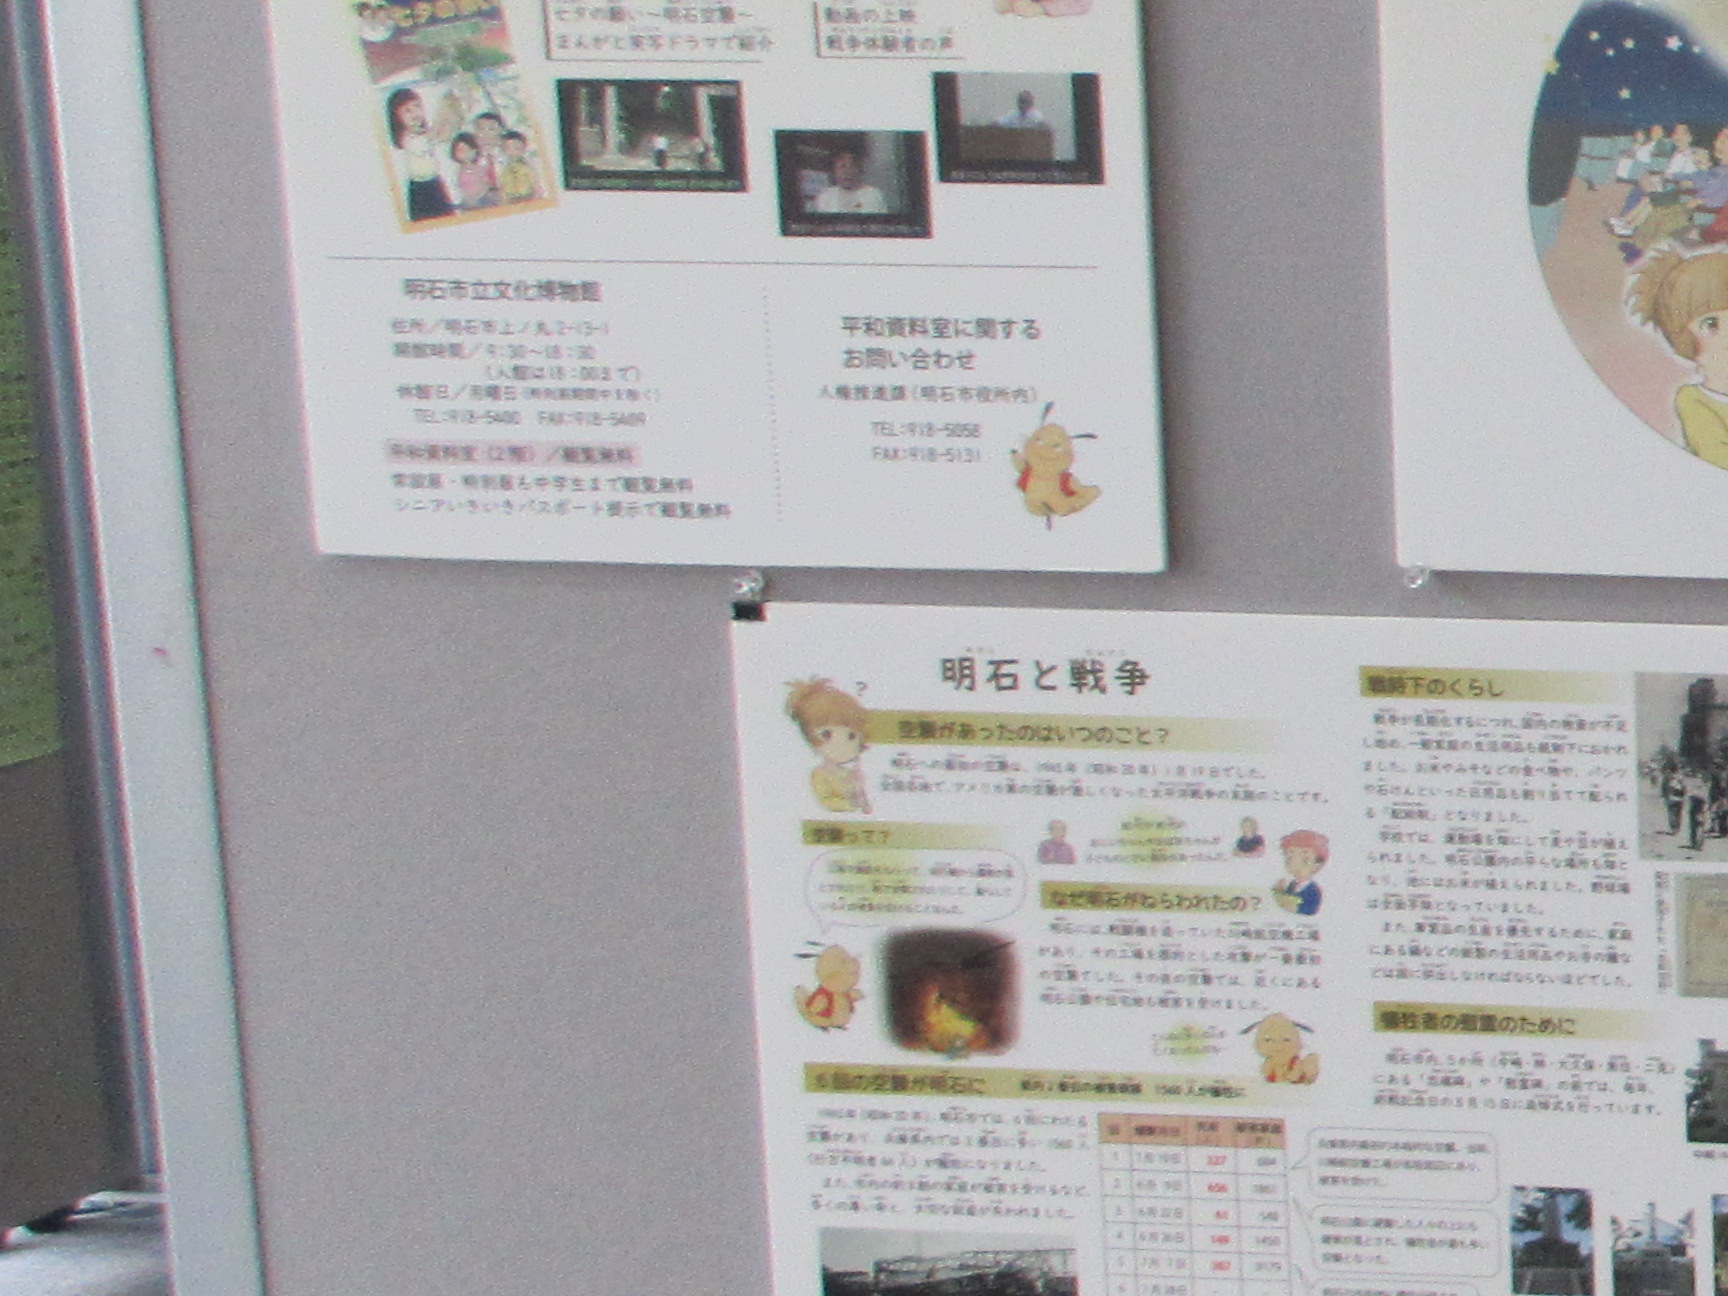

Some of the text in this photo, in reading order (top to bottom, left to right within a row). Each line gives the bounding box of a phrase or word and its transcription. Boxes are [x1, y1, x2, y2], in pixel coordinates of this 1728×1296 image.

[842, 348, 977, 370] お問い合わせ
[940, 655, 1151, 695] 明石と戦争
